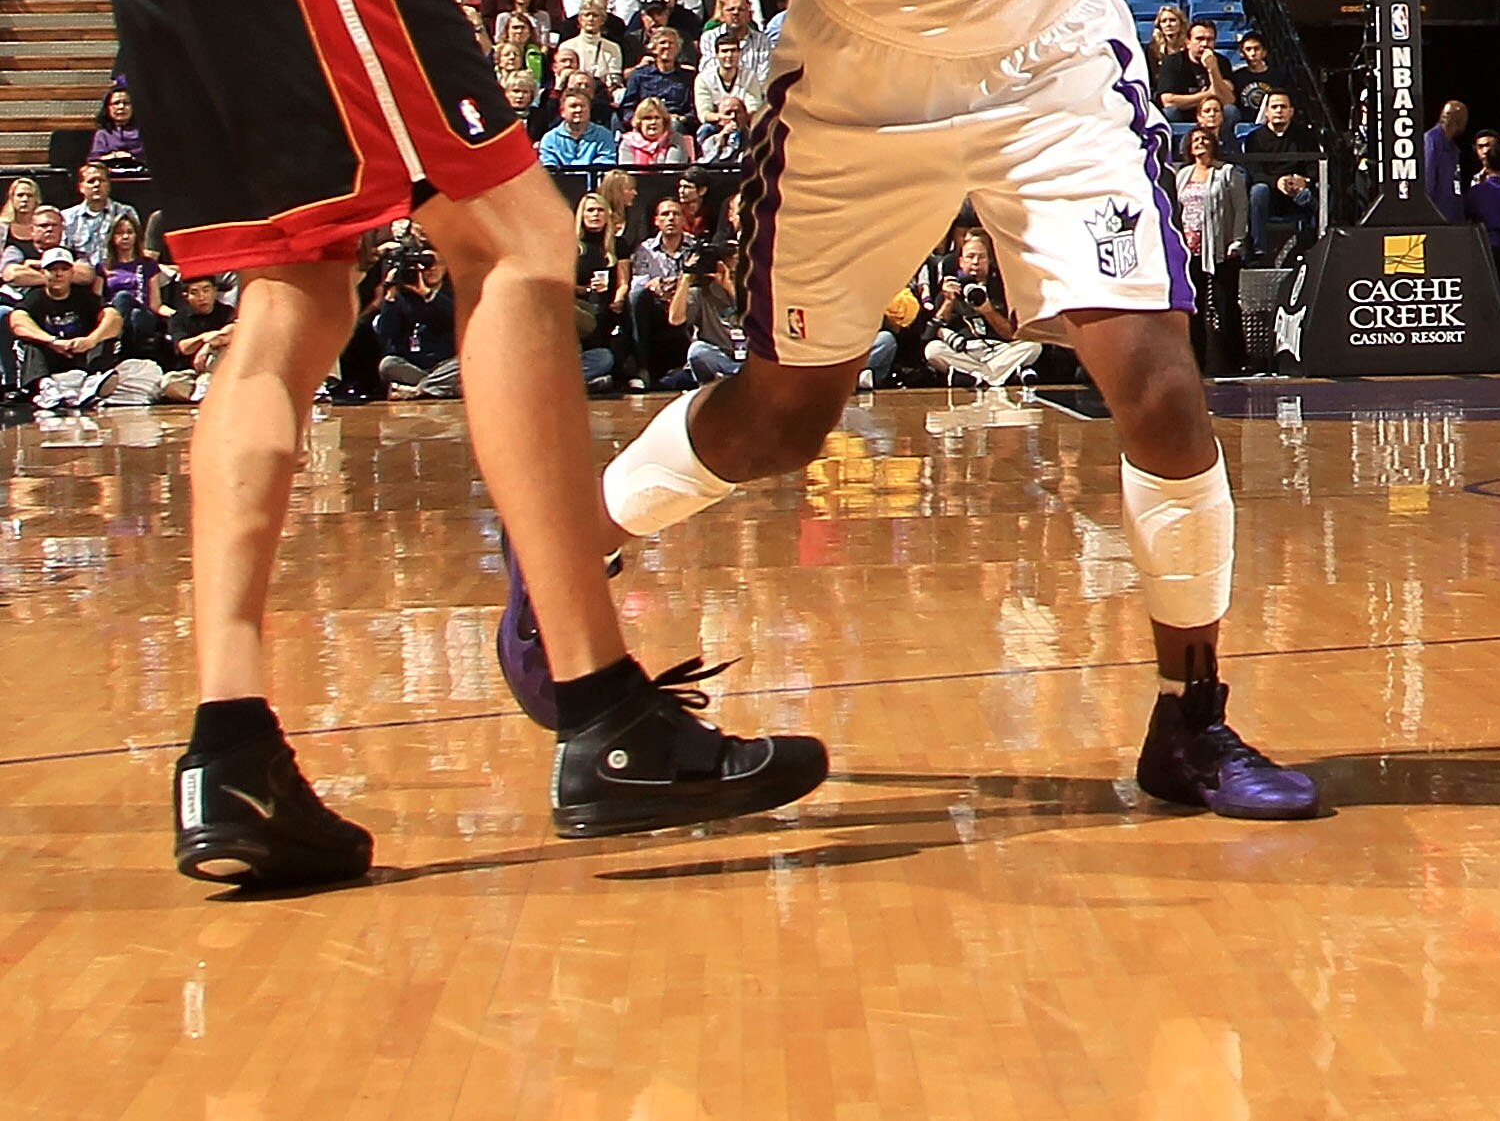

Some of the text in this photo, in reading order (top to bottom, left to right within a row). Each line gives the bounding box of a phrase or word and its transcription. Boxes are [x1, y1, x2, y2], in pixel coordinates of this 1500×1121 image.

[1391, 46, 1417, 180] NBA.COM
[1348, 278, 1464, 303] CACHE
[1349, 303, 1466, 329] CREEK
[1349, 330, 1466, 346] CASINO RESORT
